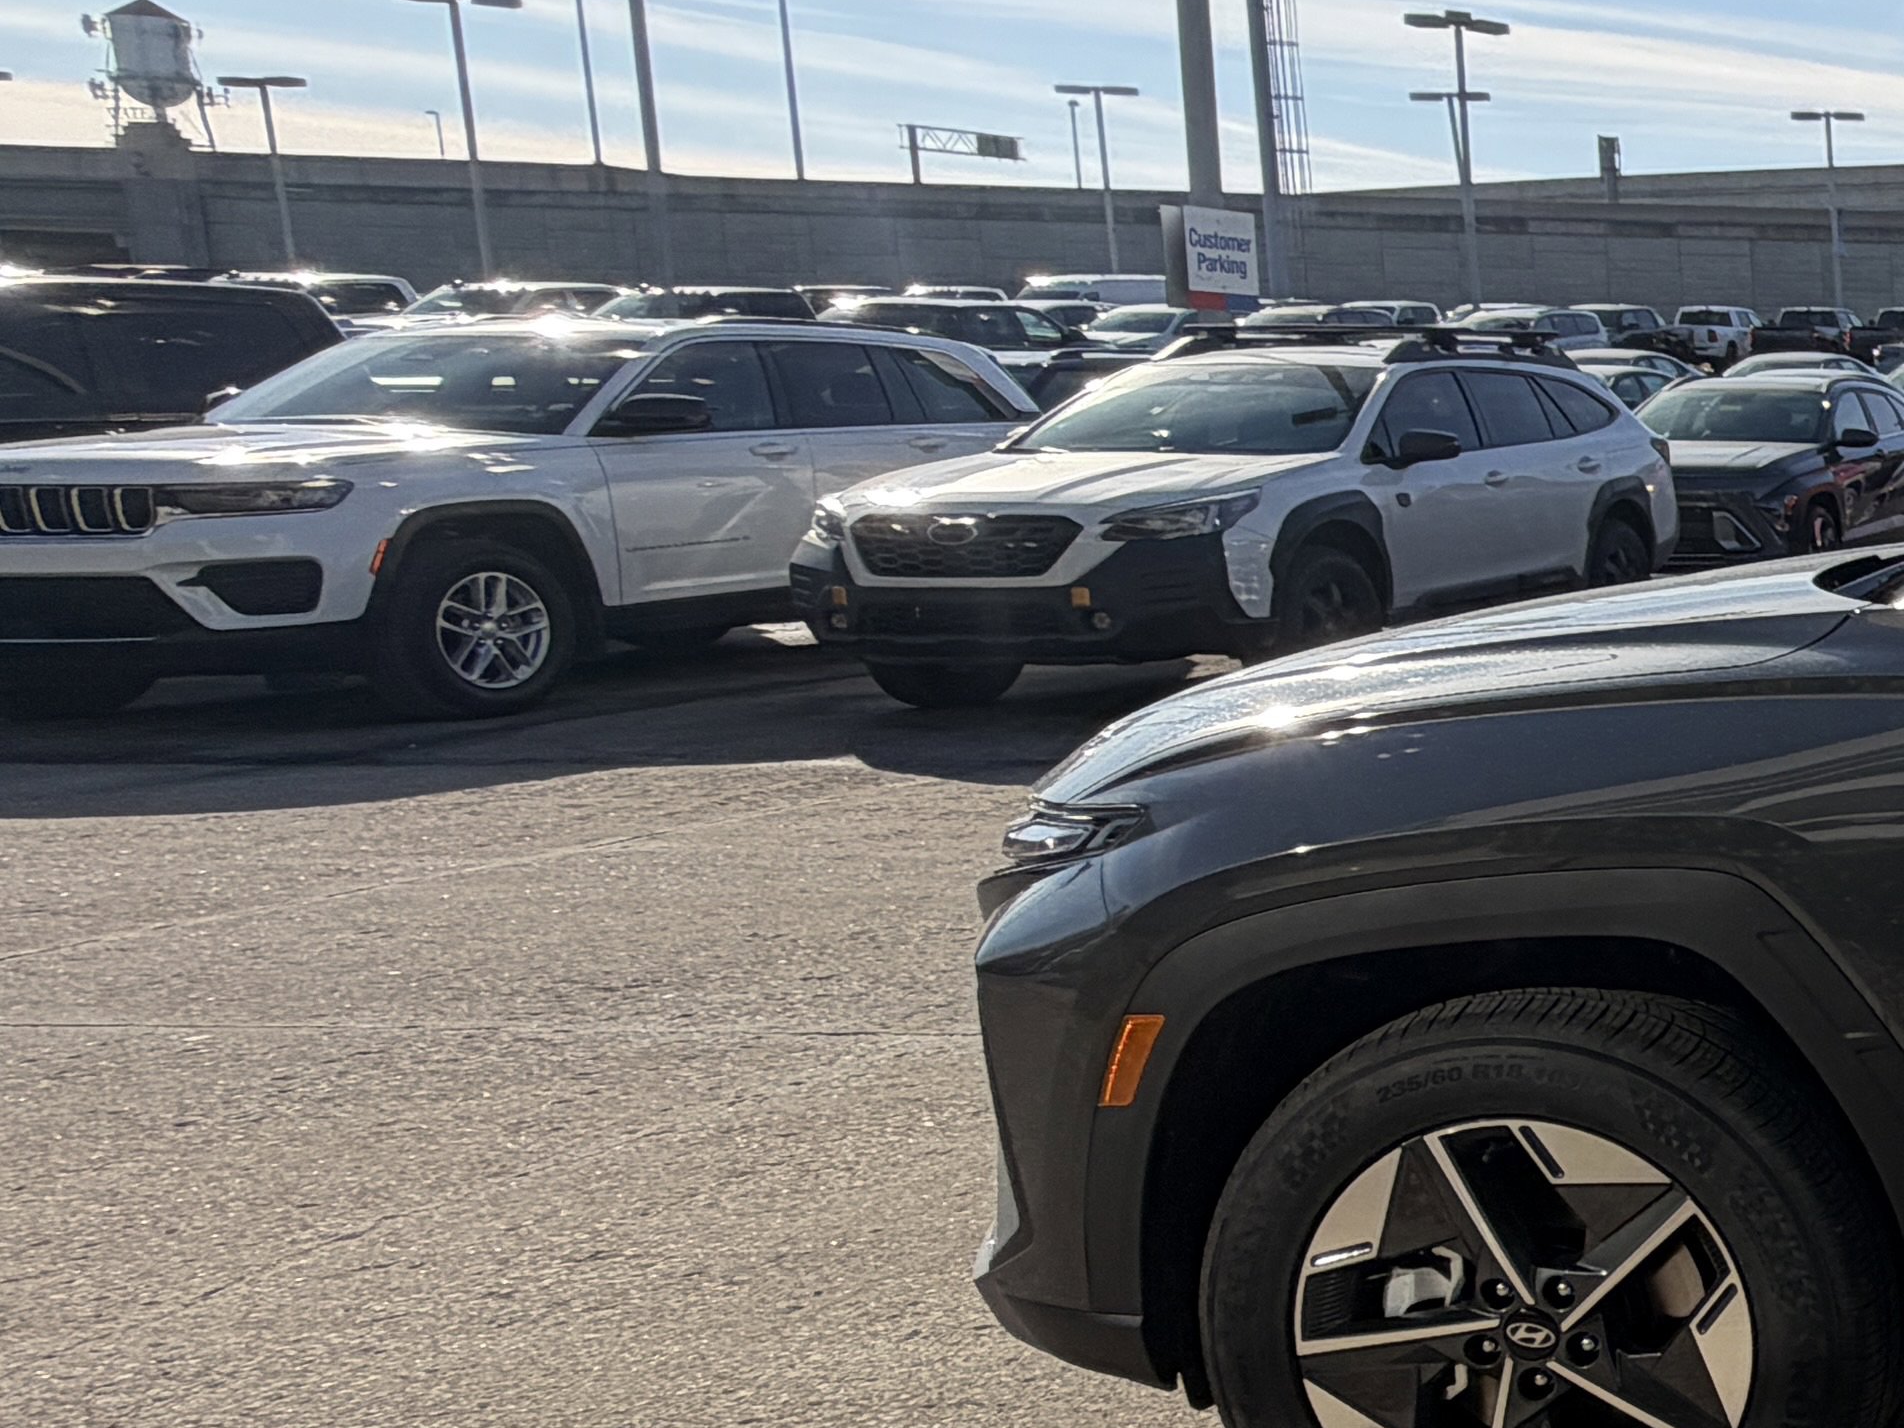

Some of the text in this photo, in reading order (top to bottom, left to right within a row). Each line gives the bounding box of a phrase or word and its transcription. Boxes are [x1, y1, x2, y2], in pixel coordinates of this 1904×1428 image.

[1190, 227, 1251, 252] Customer
[1197, 252, 1247, 279] Parking
[1376, 1065, 1463, 1104] 235/60
[1472, 1063, 1524, 1081] R18
